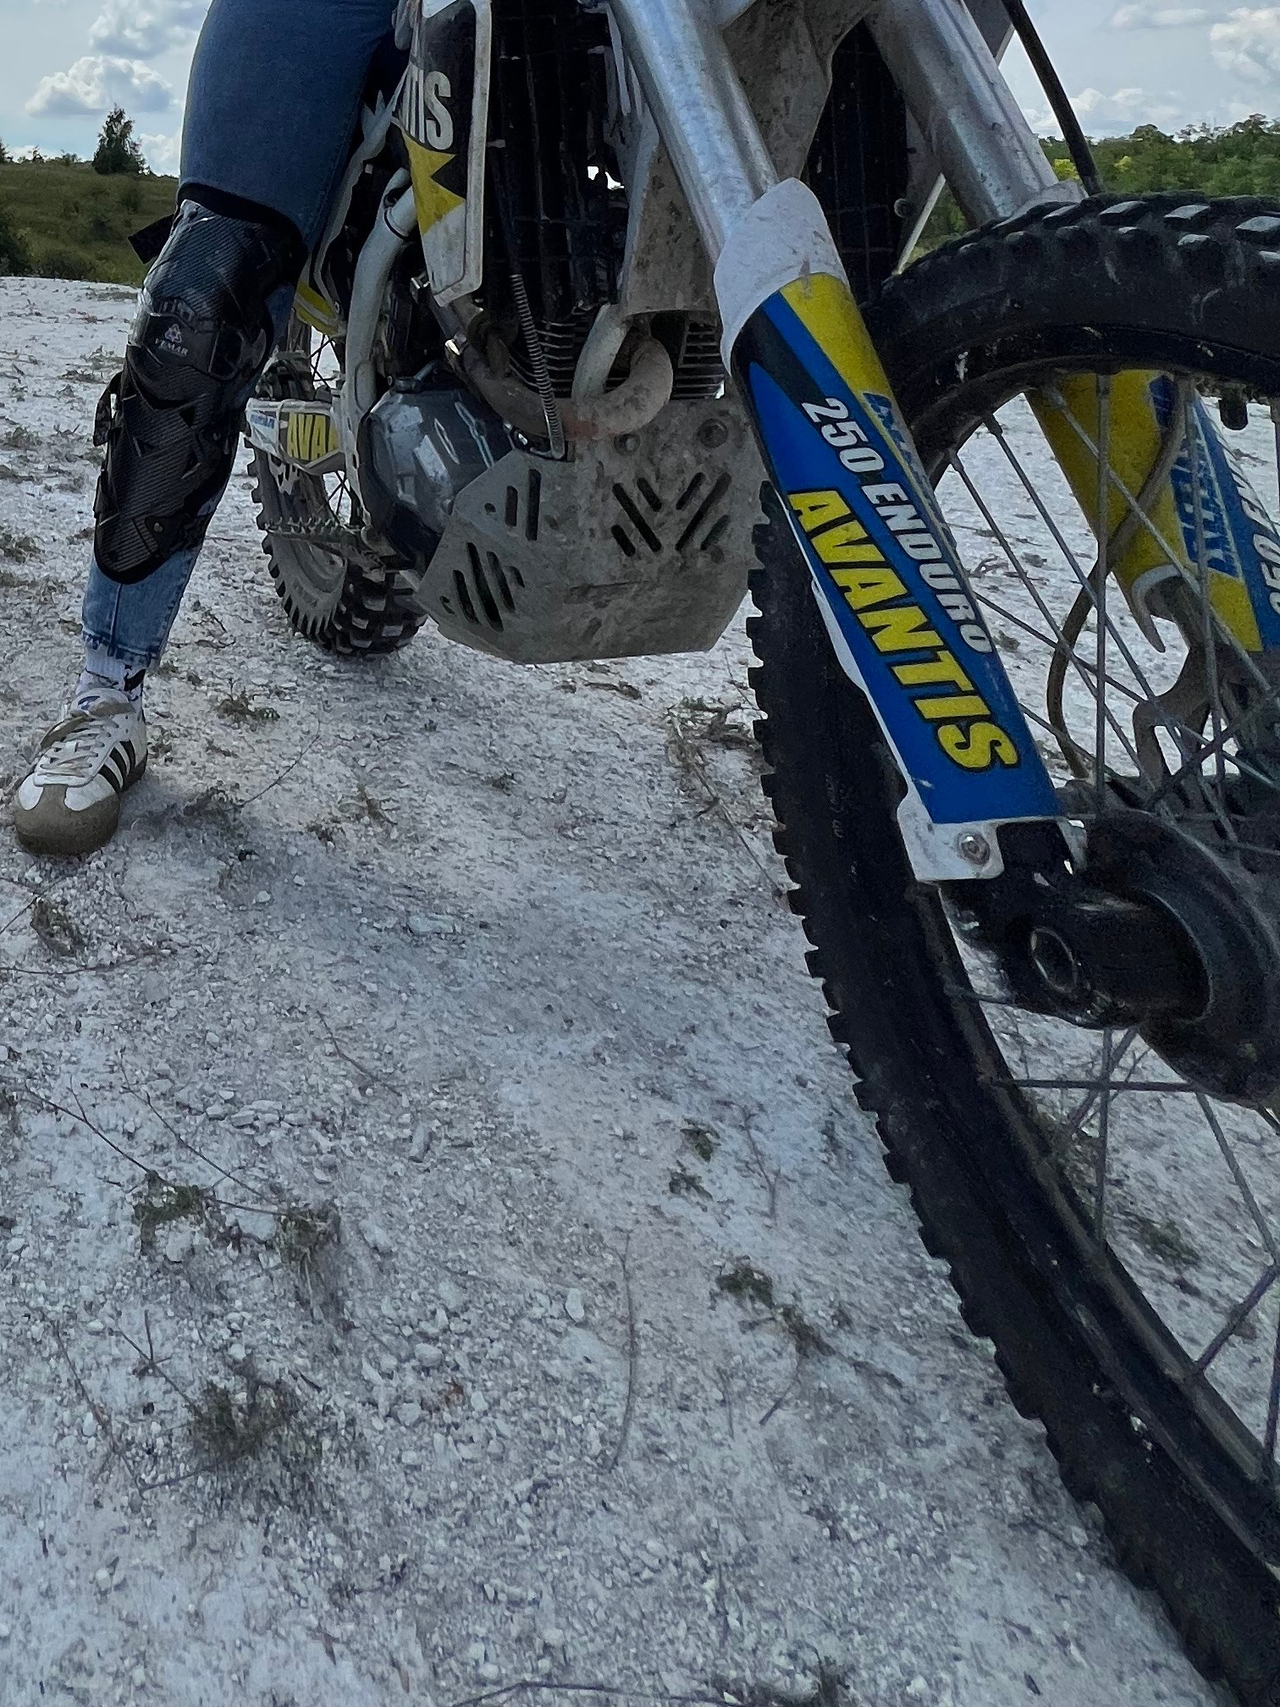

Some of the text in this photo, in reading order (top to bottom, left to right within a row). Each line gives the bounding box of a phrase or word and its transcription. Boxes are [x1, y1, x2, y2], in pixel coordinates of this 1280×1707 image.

[786, 490, 1019, 769] AVANTIS
[801, 397, 885, 473] 250
[861, 482, 993, 653] ENDURO
